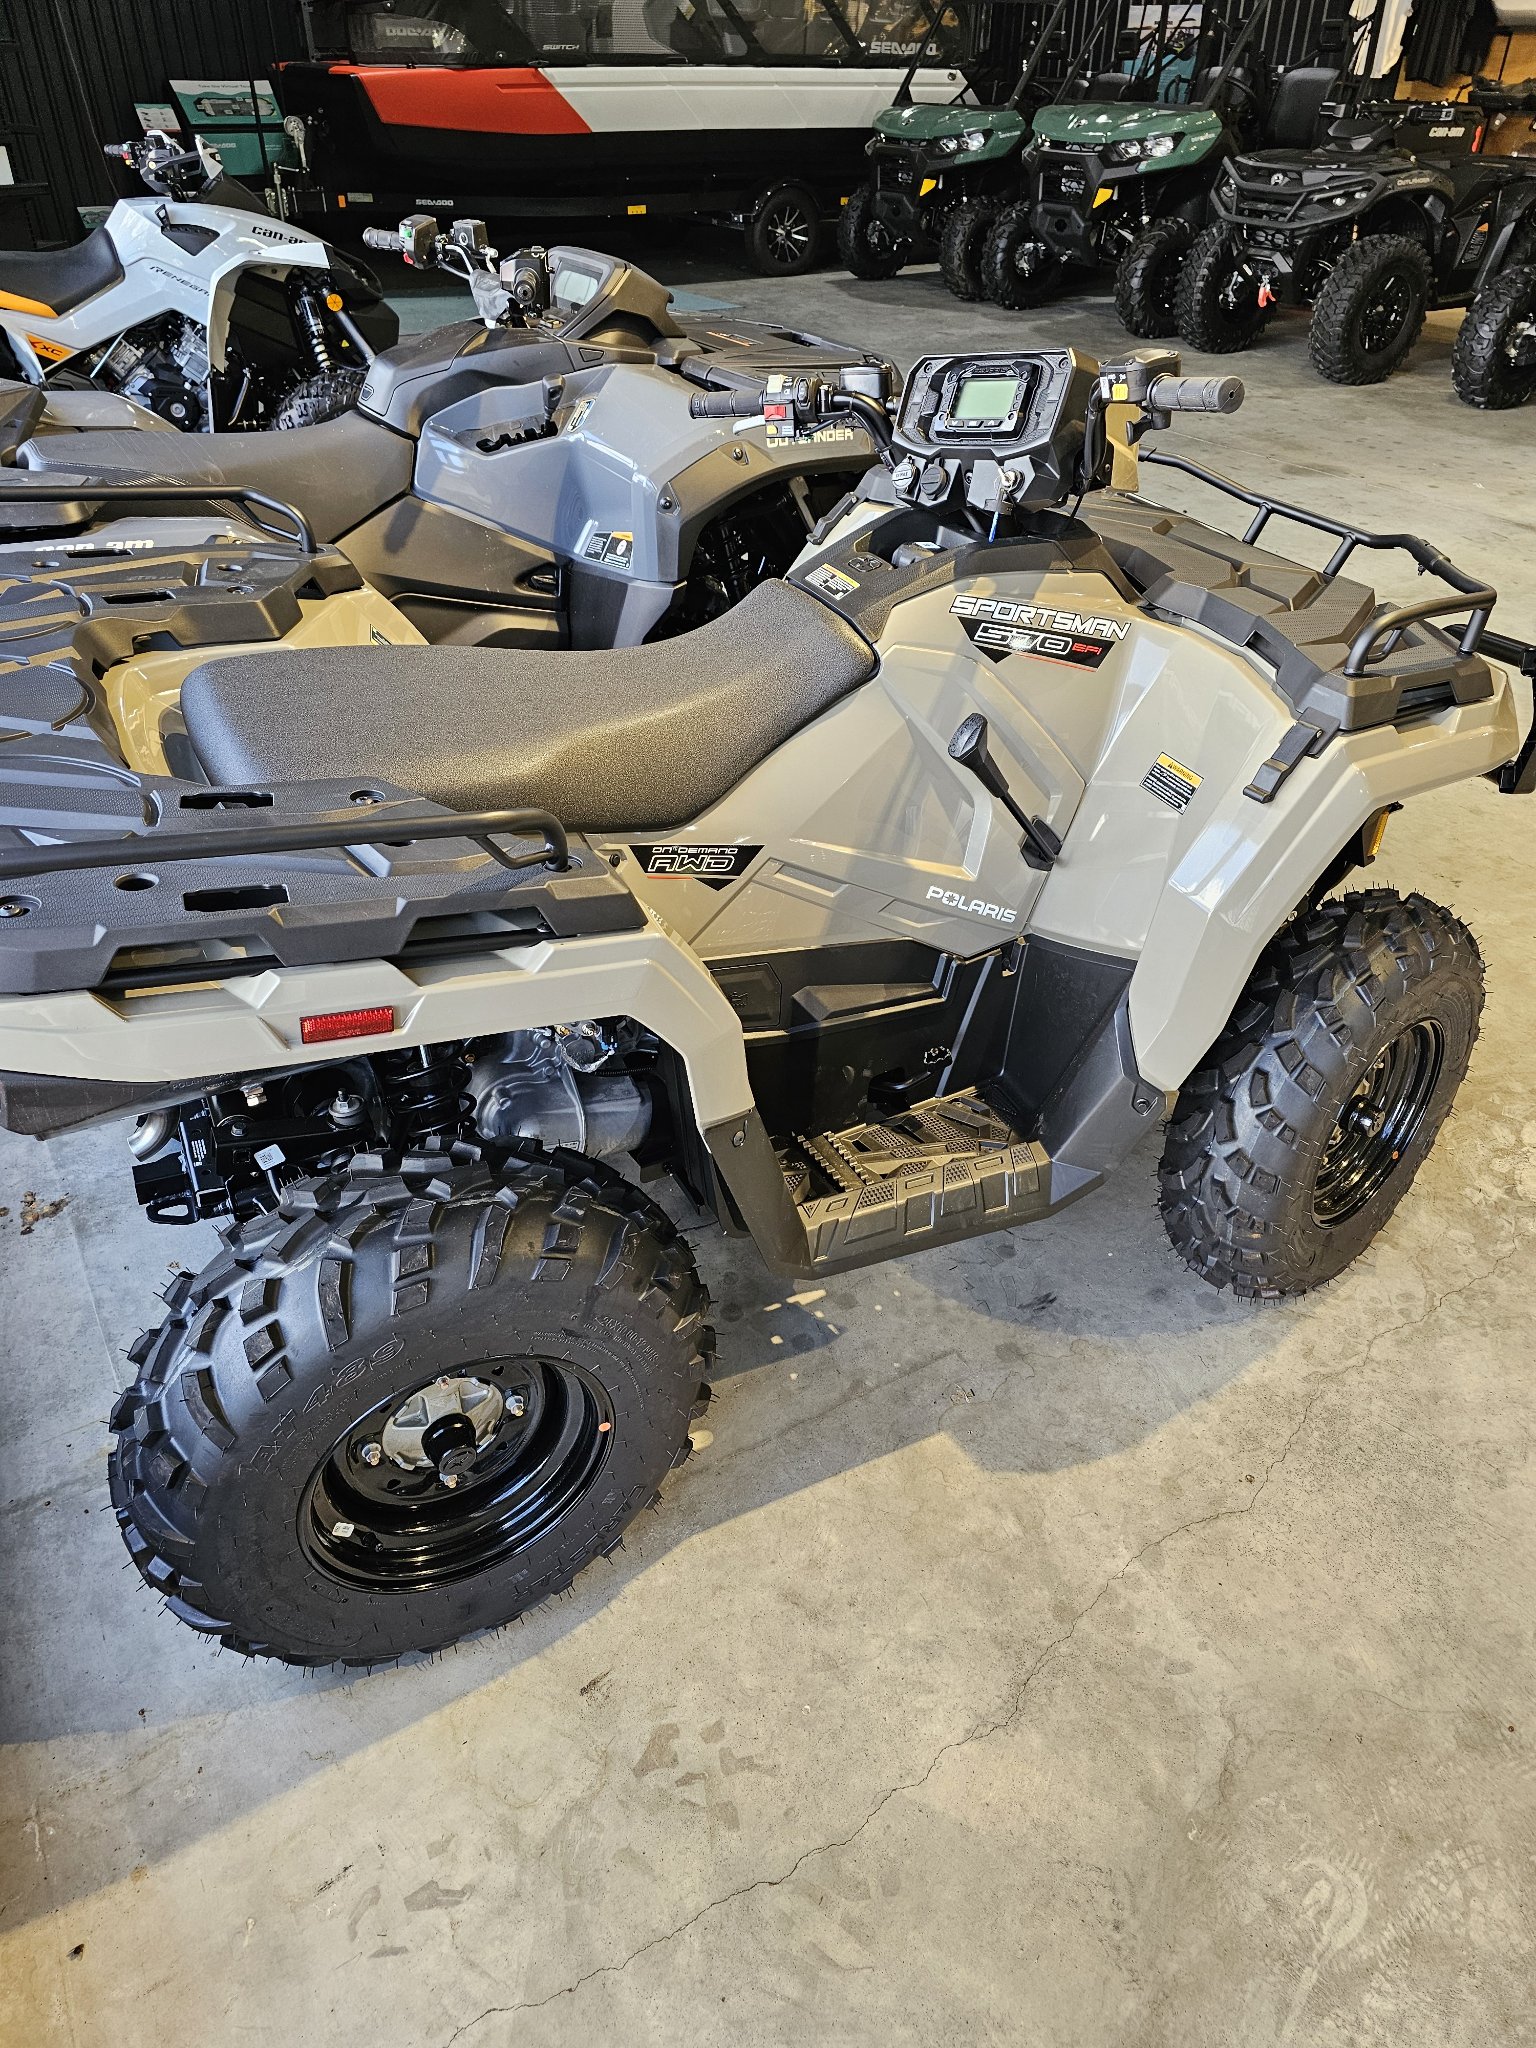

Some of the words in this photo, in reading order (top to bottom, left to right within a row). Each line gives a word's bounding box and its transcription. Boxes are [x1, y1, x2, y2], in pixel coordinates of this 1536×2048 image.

[542, 43, 580, 51] SWITCH
[150, 266, 210, 297] RENEGA
[949, 594, 1131, 640] SPORTSMAN
[974, 622, 1073, 655] 570
[1072, 642, 1103, 656] EFI
[647, 854, 736, 872] AWD
[925, 885, 1018, 924] POLARIS
